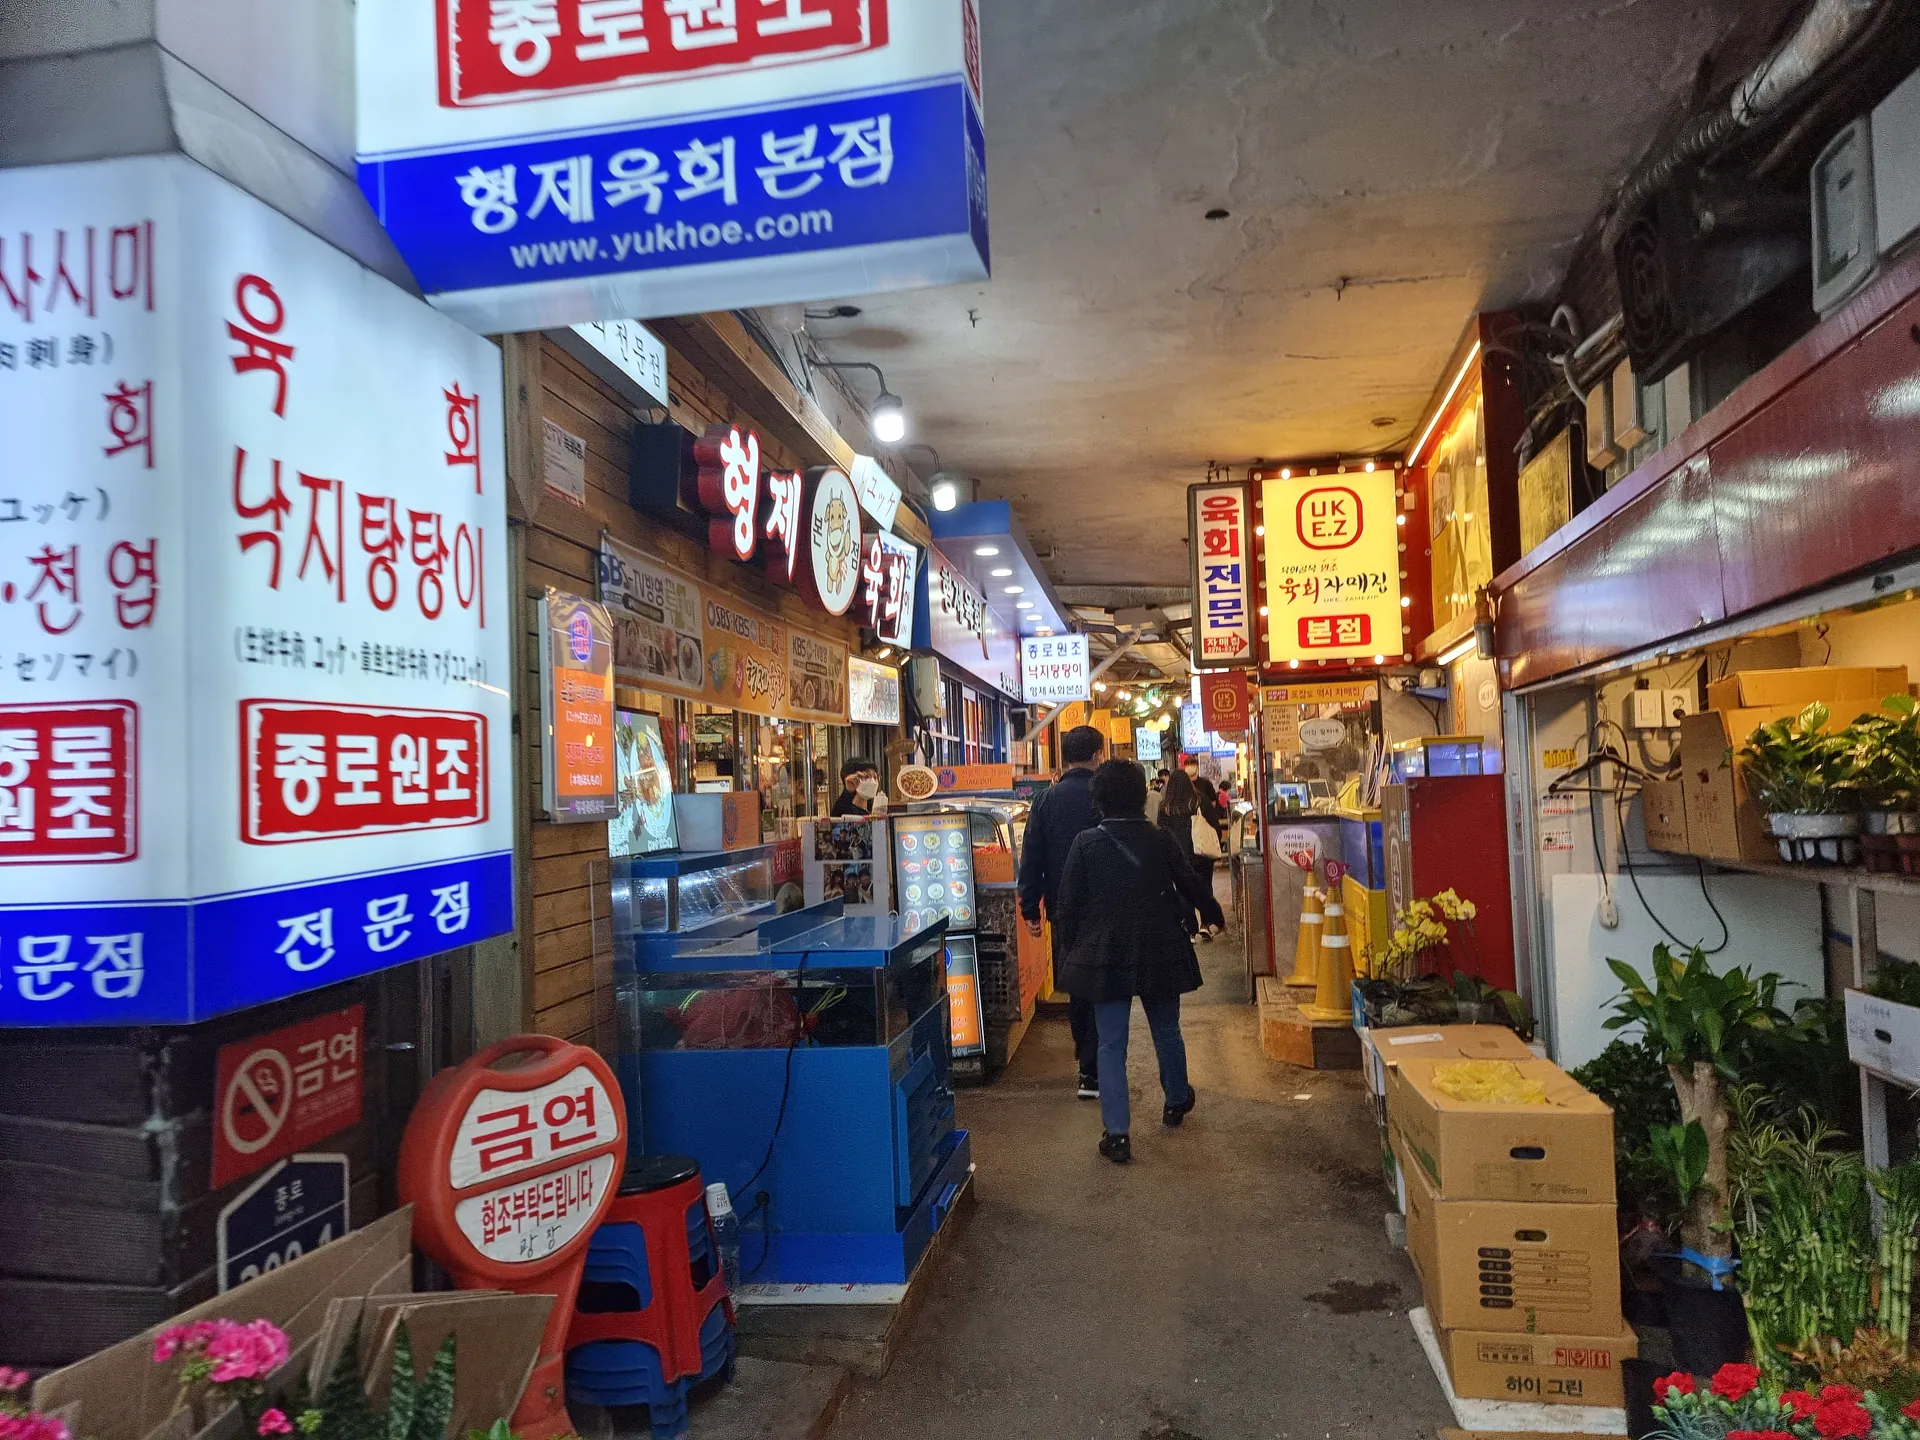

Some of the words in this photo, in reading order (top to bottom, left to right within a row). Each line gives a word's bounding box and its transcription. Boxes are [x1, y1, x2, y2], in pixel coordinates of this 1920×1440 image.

[456, 136, 738, 235] 형제육회
[754, 114, 895, 201] 본점
[0, 218, 157, 323] 사시미
[511, 205, 834, 270] www.yukhoe.com
[102, 379, 157, 470] 회
[231, 444, 486, 631] 낙지탕탕이
[1311, 499, 1347, 518] UK
[1312, 520, 1348, 538] E.Z
[862, 535, 909, 642] 육회
[1028, 641, 1082, 660] 종로원조
[1028, 662, 1083, 680] 낙지탕탕이
[1306, 616, 1362, 646] 본점
[273, 732, 473, 817] 종로원조
[0, 932, 146, 1002] 문점
[274, 881, 473, 973] 전문점
[294, 1026, 358, 1097] 금연
[470, 1085, 598, 1173] 금연
[481, 1164, 593, 1246] 협조부탁드립니다
